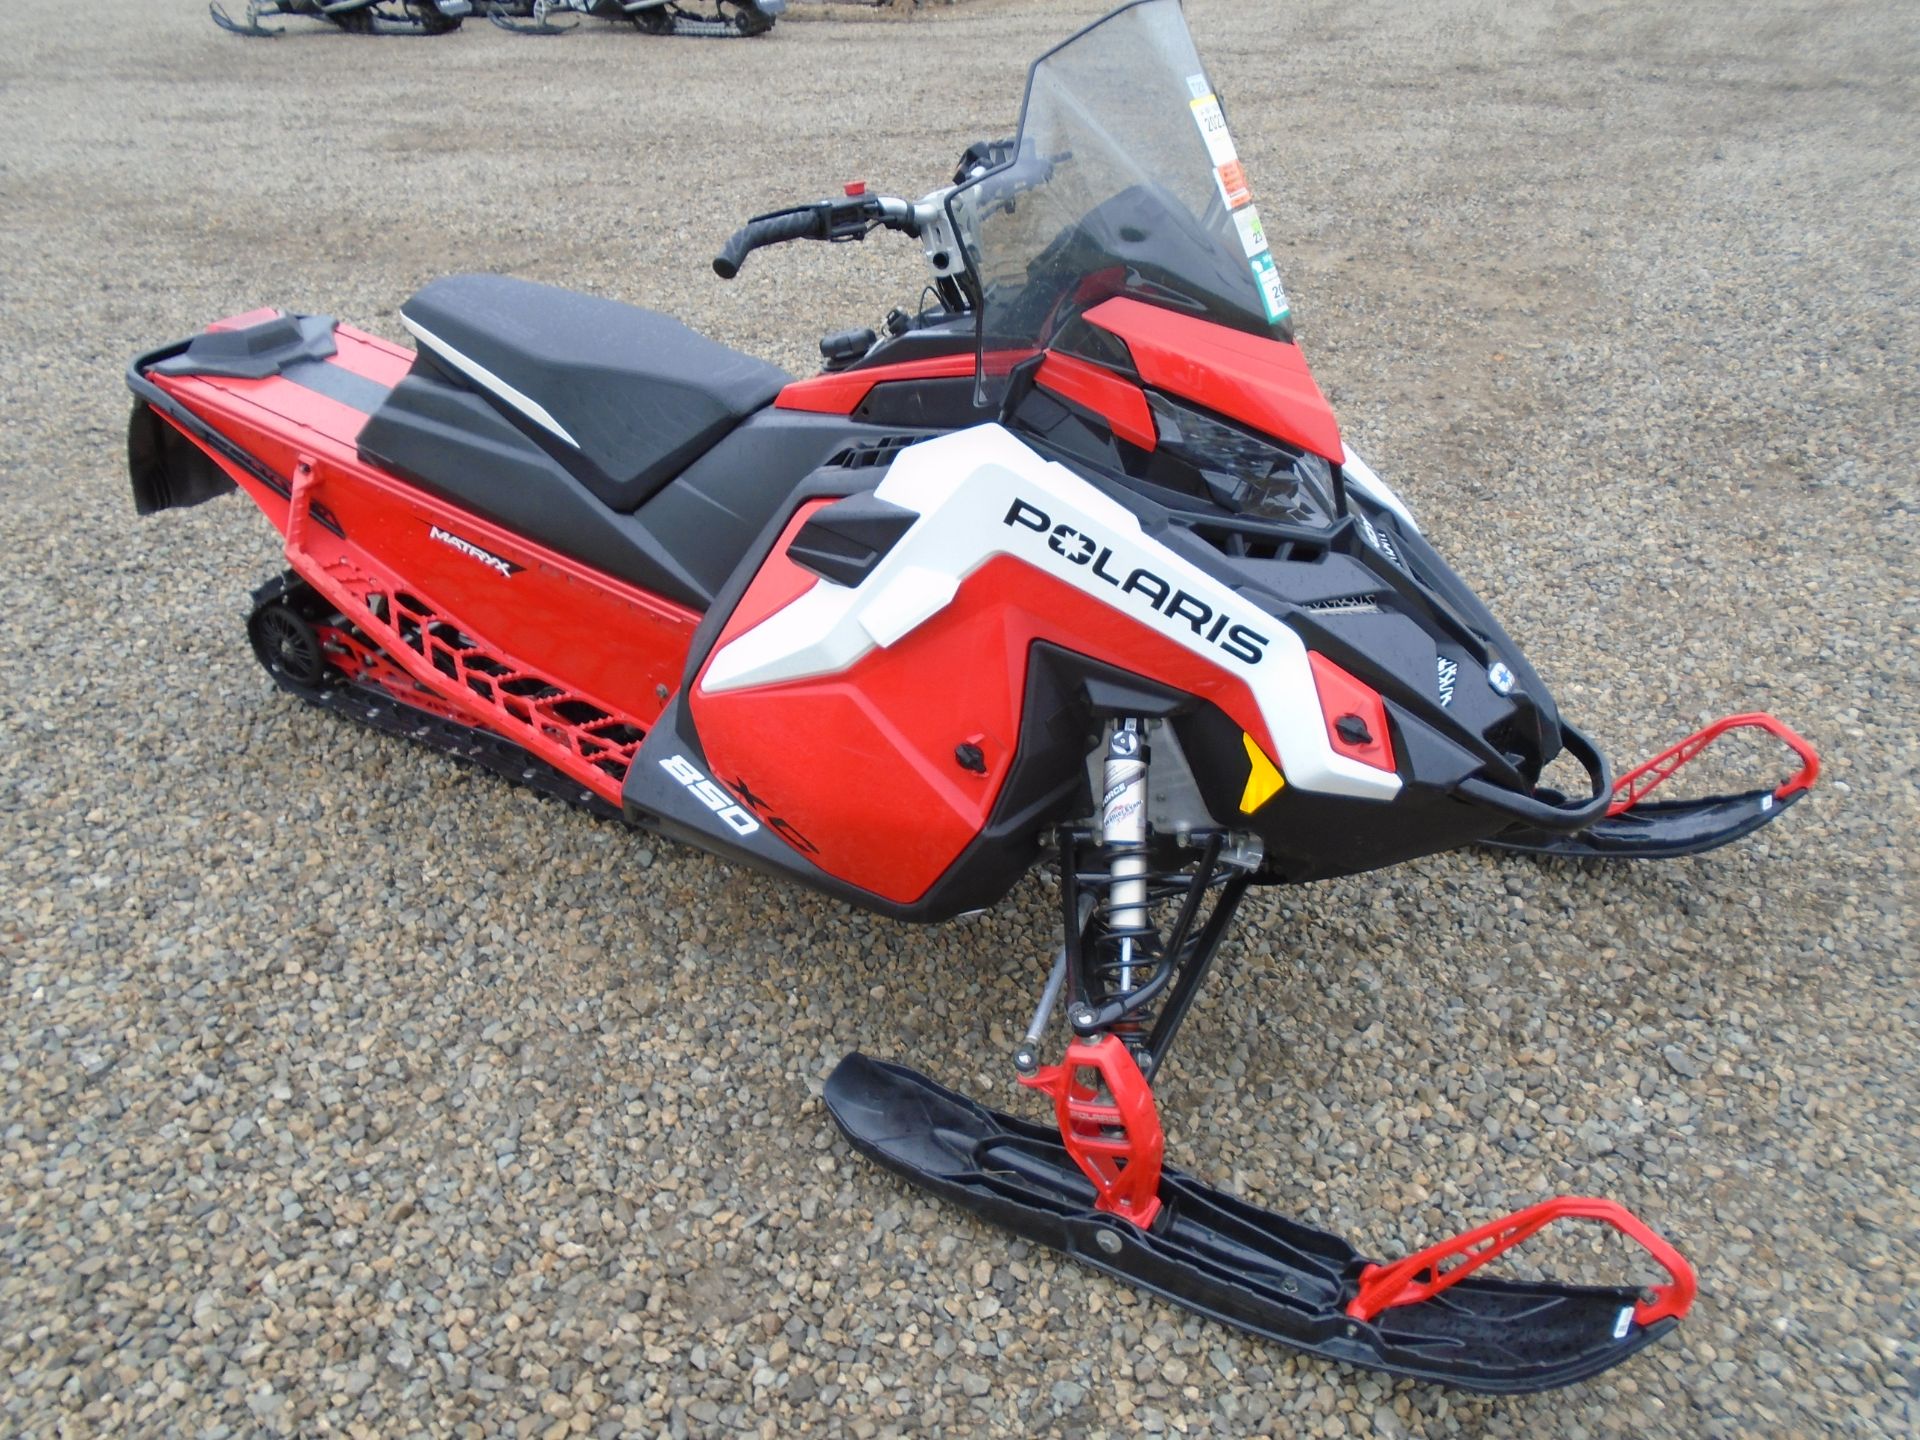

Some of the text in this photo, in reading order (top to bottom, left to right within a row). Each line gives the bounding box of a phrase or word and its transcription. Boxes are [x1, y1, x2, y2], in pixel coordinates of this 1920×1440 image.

[429, 525, 512, 578] MATRYX
[1003, 497, 1270, 664] POLARIS
[659, 754, 760, 836] 850
